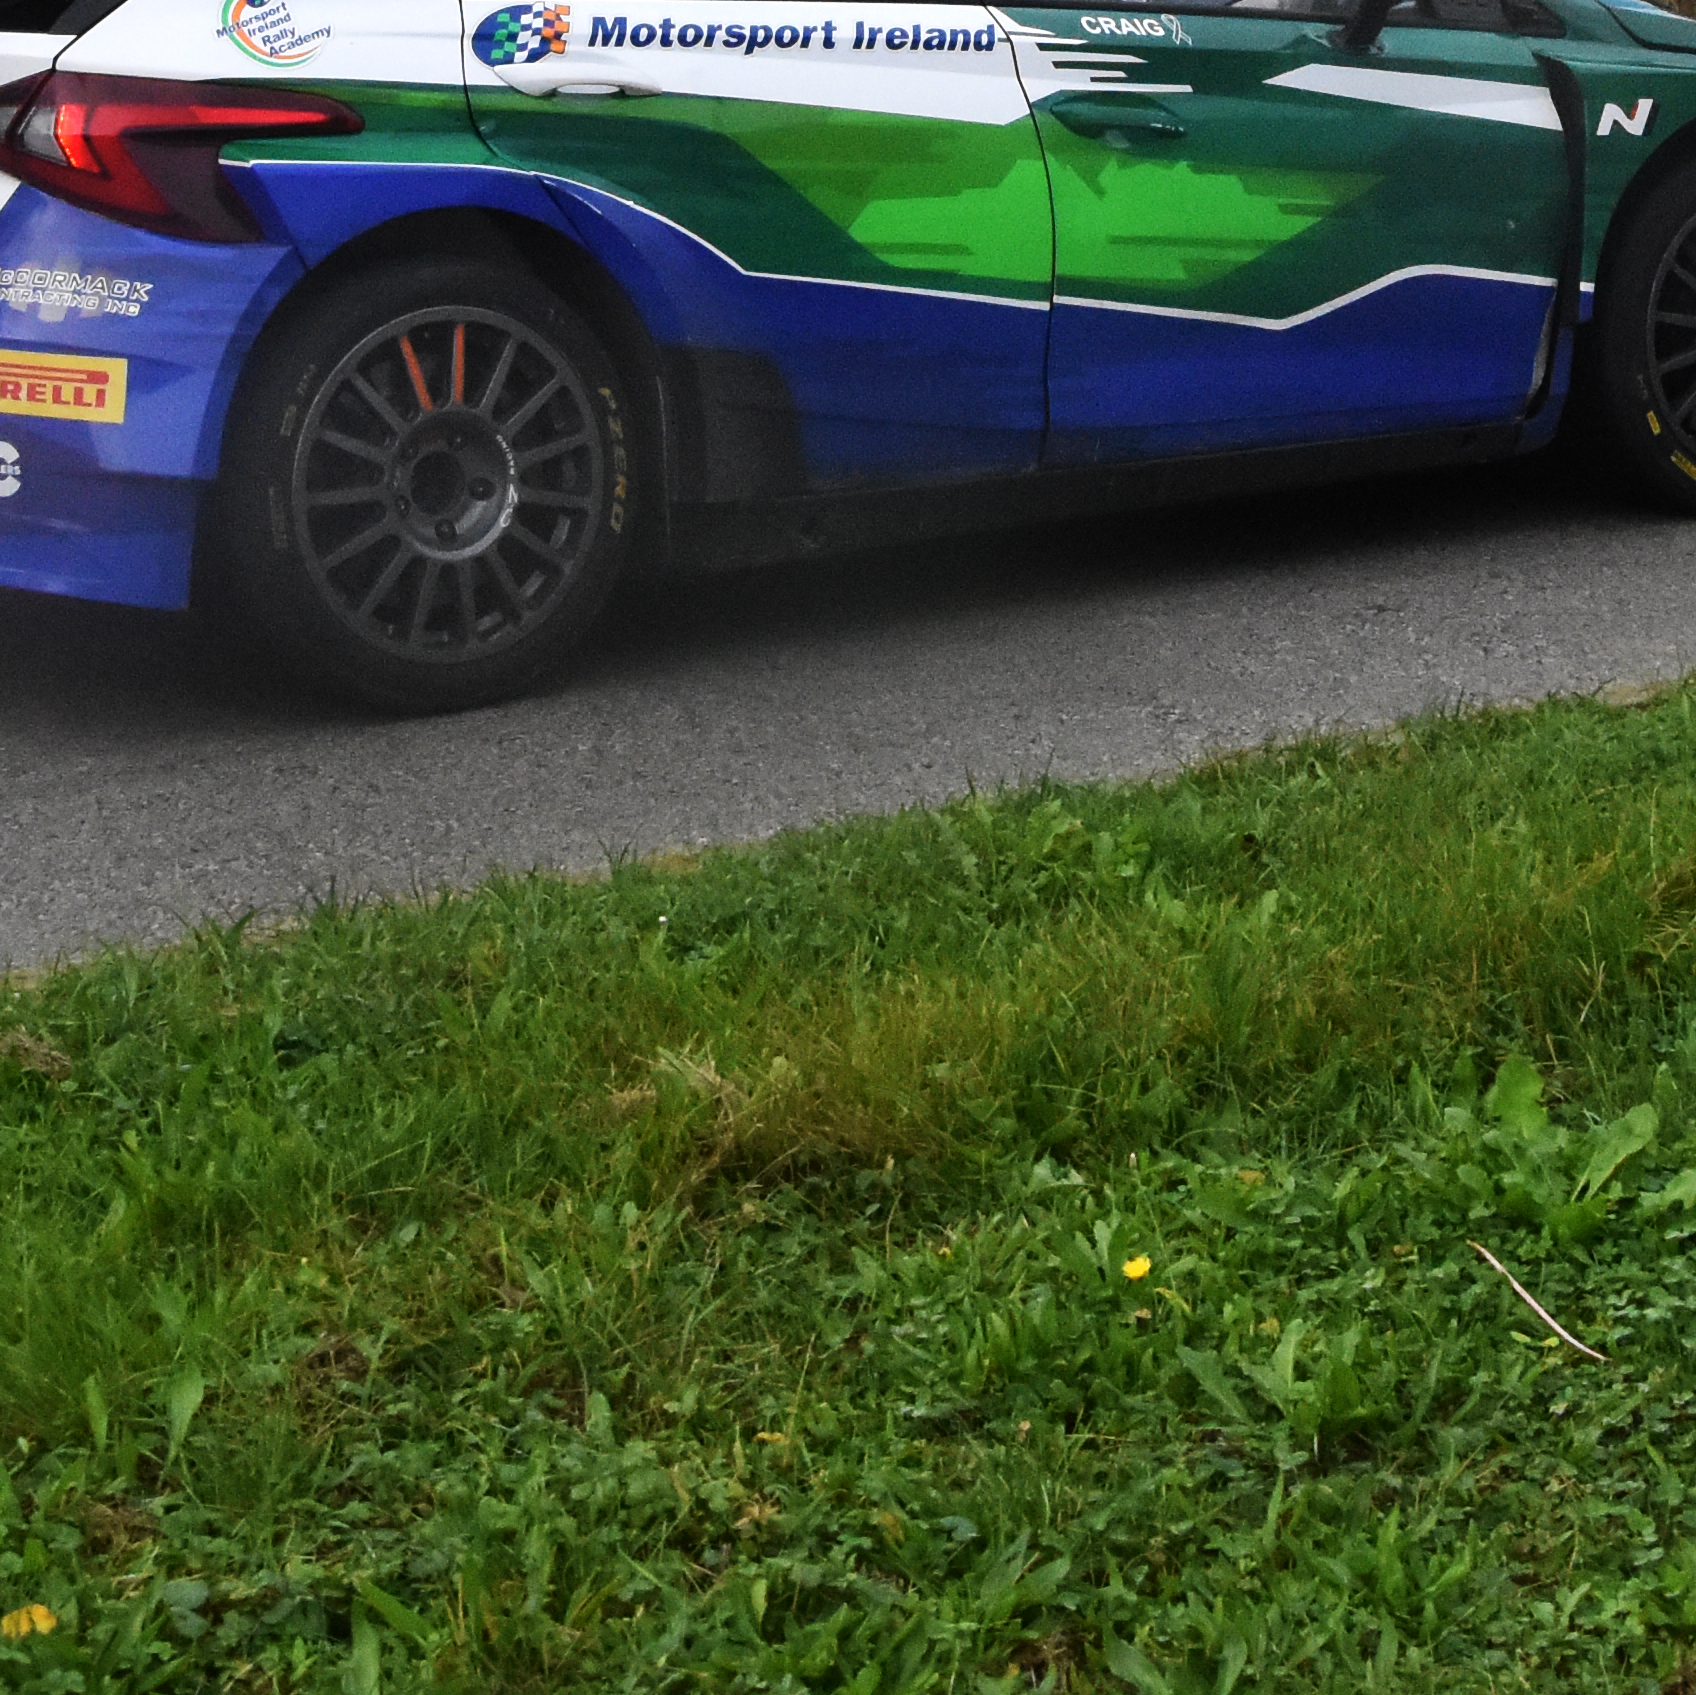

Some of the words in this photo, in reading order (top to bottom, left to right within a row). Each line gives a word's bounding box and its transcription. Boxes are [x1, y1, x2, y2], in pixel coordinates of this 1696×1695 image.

[216, 1, 288, 39] Motorsport
[247, 12, 292, 38] Ireland
[1080, 16, 1166, 37] CRAIG
[261, 26, 297, 47] Rally
[269, 25, 332, 58] Academy
[587, 16, 836, 55] Motorsport
[851, 20, 996, 52] Ireland
[104, 298, 141, 318] INC
